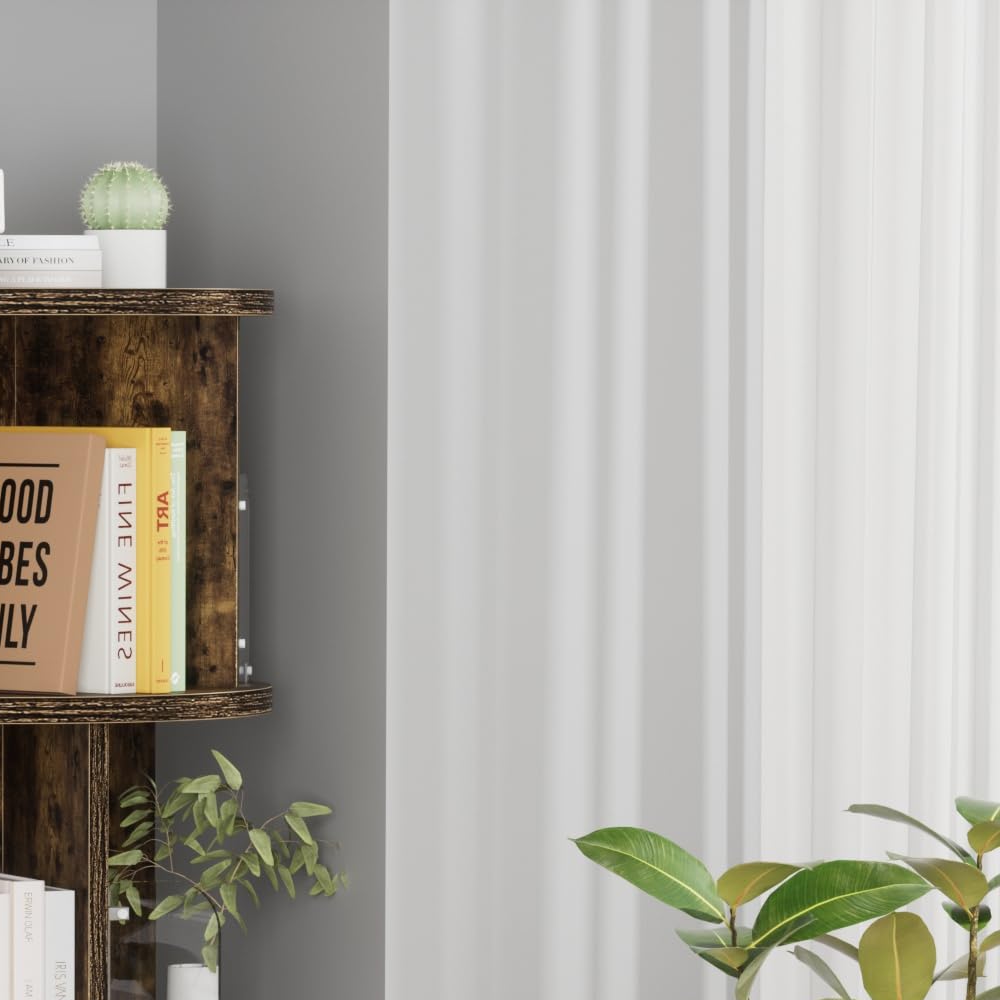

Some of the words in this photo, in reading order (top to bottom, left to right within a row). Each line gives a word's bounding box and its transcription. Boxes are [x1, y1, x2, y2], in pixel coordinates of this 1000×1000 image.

[16, 256, 30, 265] OF
[31, 256, 76, 265] FASHION
[23, 892, 33, 921] ERWIN
[55, 961, 67, 981] IRIS
